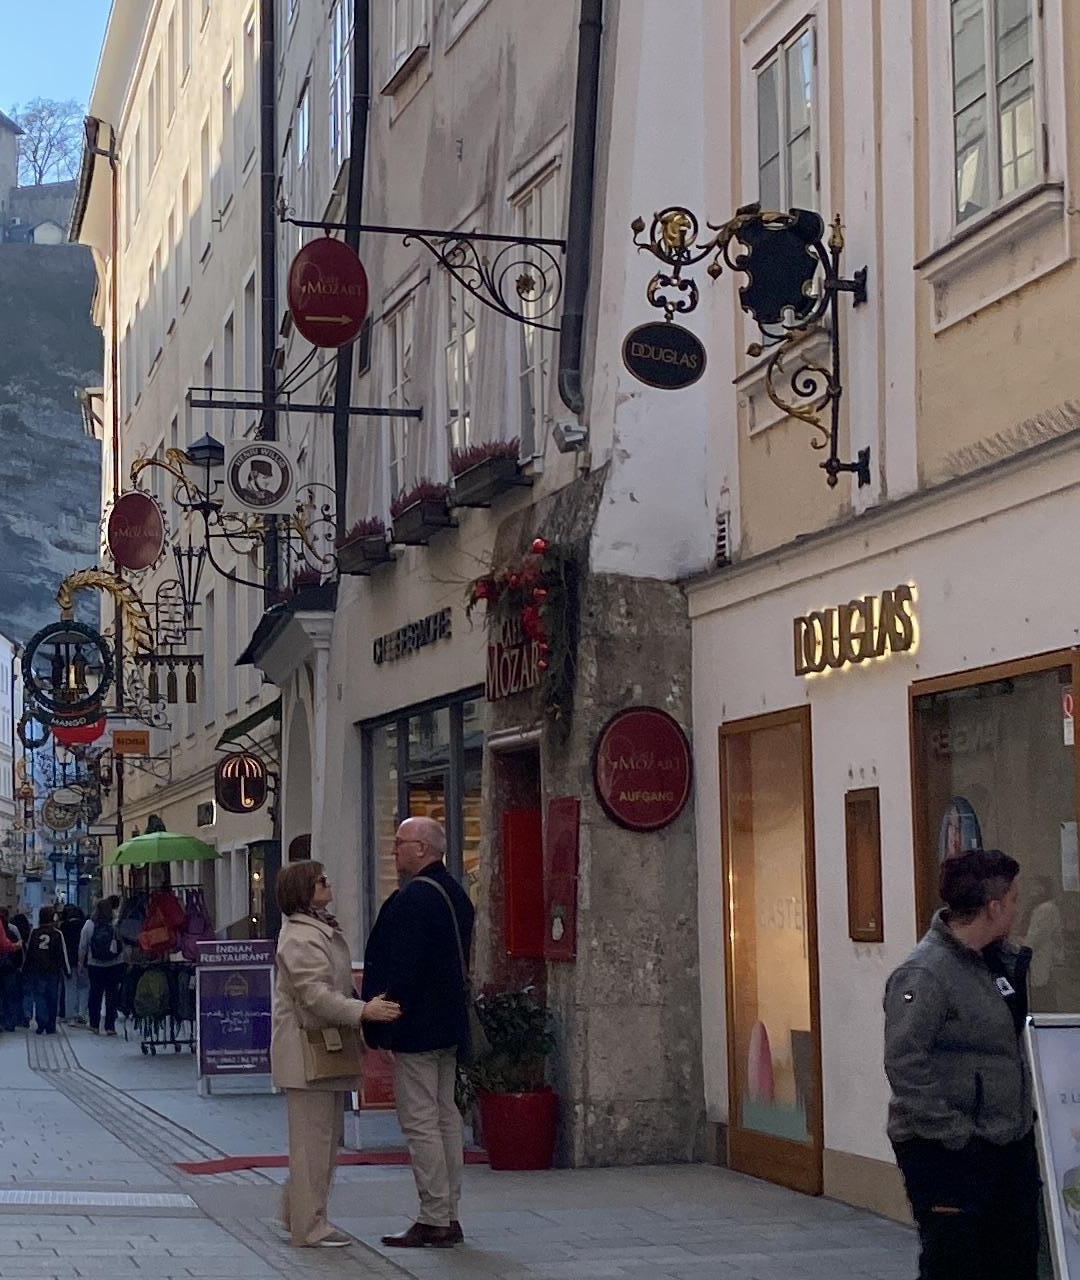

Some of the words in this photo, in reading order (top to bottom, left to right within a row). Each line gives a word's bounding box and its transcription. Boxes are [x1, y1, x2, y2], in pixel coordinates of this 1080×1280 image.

[631, 342, 697, 369] DOUGLAS
[793, 584, 914, 677] DOUGLAS
[486, 641, 541, 701] MOZAR
[619, 790, 674, 802] AUFGANG
[38, 933, 51, 950] 2
[216, 944, 253, 954] INDIAN
[200, 952, 270, 963] RESTAURANT
